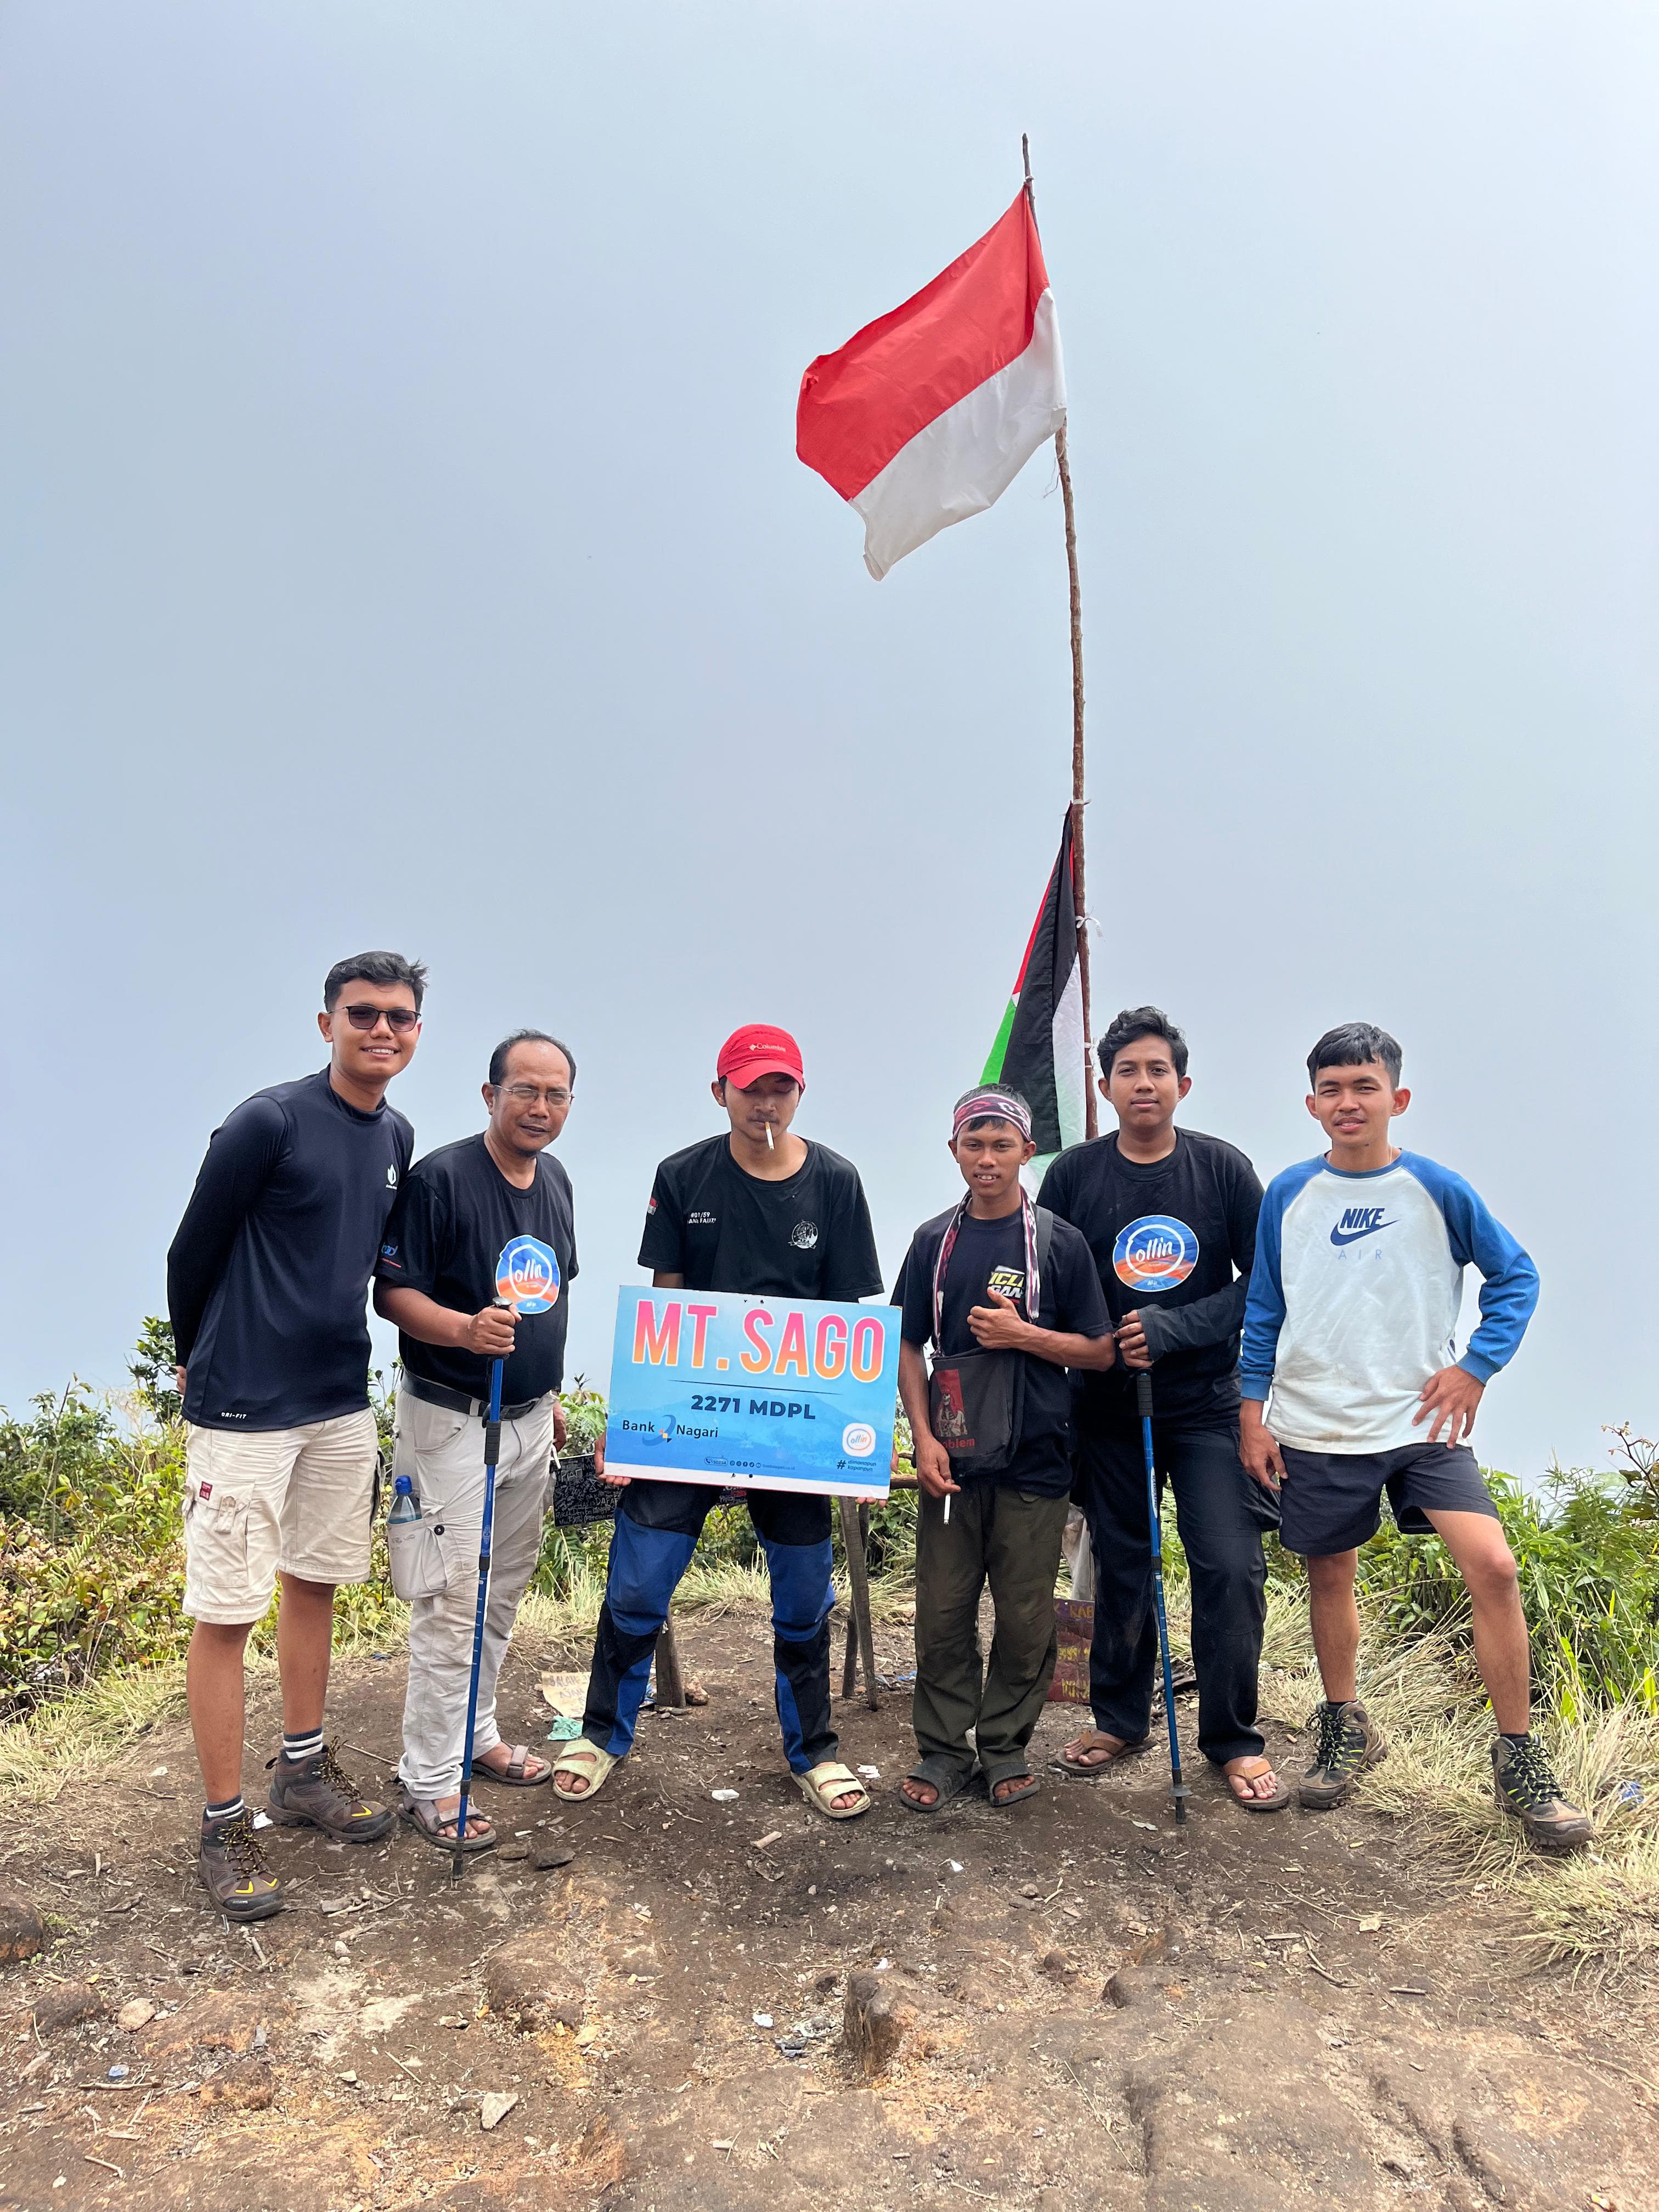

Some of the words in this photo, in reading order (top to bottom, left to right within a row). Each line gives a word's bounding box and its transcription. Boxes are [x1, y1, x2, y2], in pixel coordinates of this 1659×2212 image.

[757, 1043, 786, 1052] Columbia
[1340, 1207, 1385, 1228] NIKE
[1136, 1237, 1173, 1262] ollin
[1338, 1249, 1383, 1260] AIR
[515, 1258, 543, 1283] ollin
[632, 1299, 730, 1371] MT.
[738, 1308, 885, 1383] SAGO
[691, 1395, 741, 1414] 2271
[749, 1399, 816, 1420] MDPL
[622, 1420, 655, 1432] Bank
[676, 1424, 718, 1439] Nagari
[850, 1434, 867, 1444] ollin
